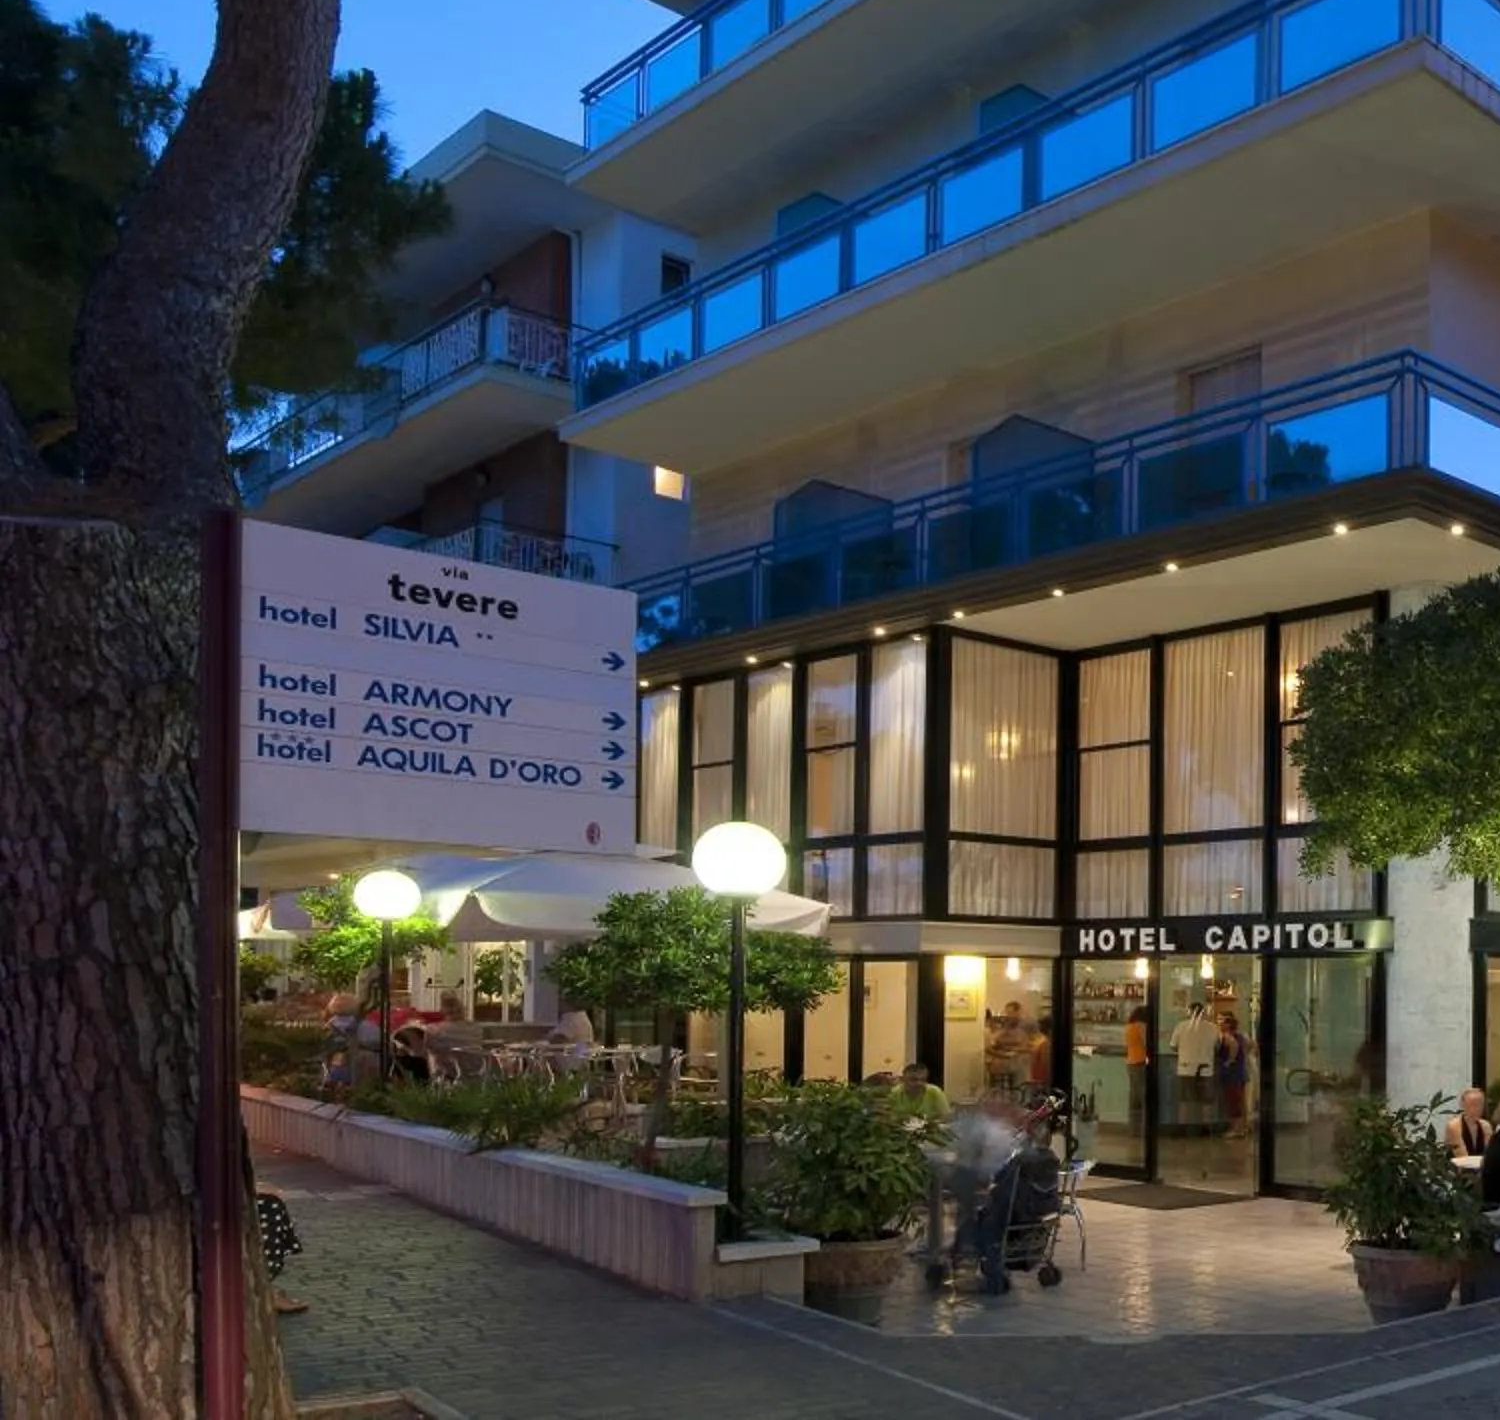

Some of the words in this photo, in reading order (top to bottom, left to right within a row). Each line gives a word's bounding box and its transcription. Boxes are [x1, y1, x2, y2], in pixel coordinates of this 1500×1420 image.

[441, 565, 469, 581] via
[388, 574, 519, 620] tevere
[260, 596, 336, 629] hotel
[364, 613, 459, 648] SILVIA
[259, 664, 336, 696] hotel
[364, 680, 513, 718] ARMONY
[258, 698, 335, 729] hotel
[363, 713, 473, 744] ASCOT
[257, 733, 331, 763] hotel
[357, 745, 476, 777] AQUILA
[490, 757, 582, 787] D'ORO
[1079, 928, 1176, 952] HOTEL
[1205, 922, 1353, 950] CAPITOL
